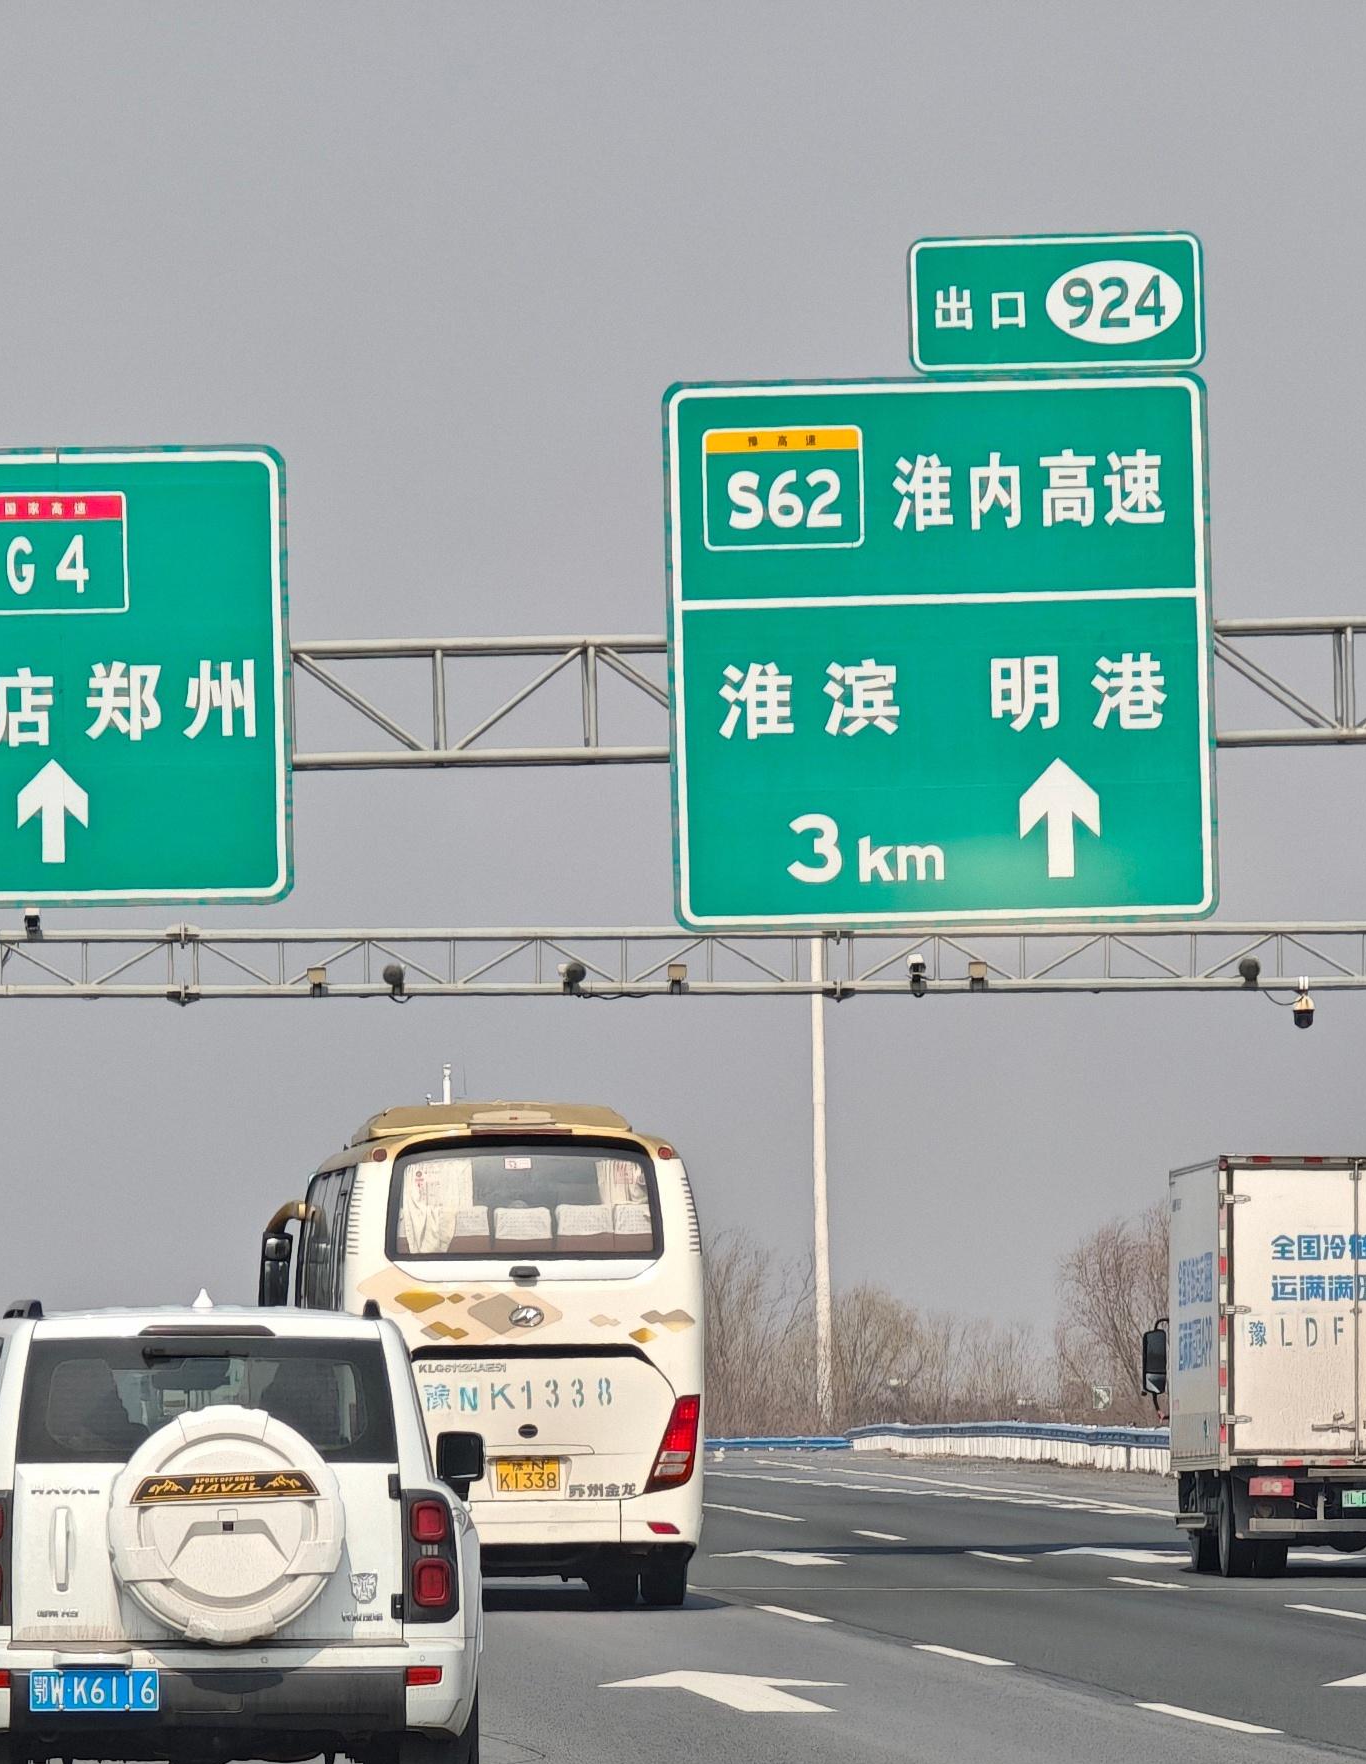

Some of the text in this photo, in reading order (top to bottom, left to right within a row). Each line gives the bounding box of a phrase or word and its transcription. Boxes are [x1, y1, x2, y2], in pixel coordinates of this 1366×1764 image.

[935, 275, 1165, 330] 出口 924
[727, 448, 1165, 532] S62 淮内高速
[4, 501, 87, 515] 国家高速
[86, 659, 257, 741] 郑州
[718, 652, 1168, 740] 淮滨 明港
[189, 1482, 262, 1494] HAVAL
[195, 1476, 219, 1484] SPORT
[500, 1472, 557, 1489] K1338
[568, 1482, 636, 1498] 苏州金龙
